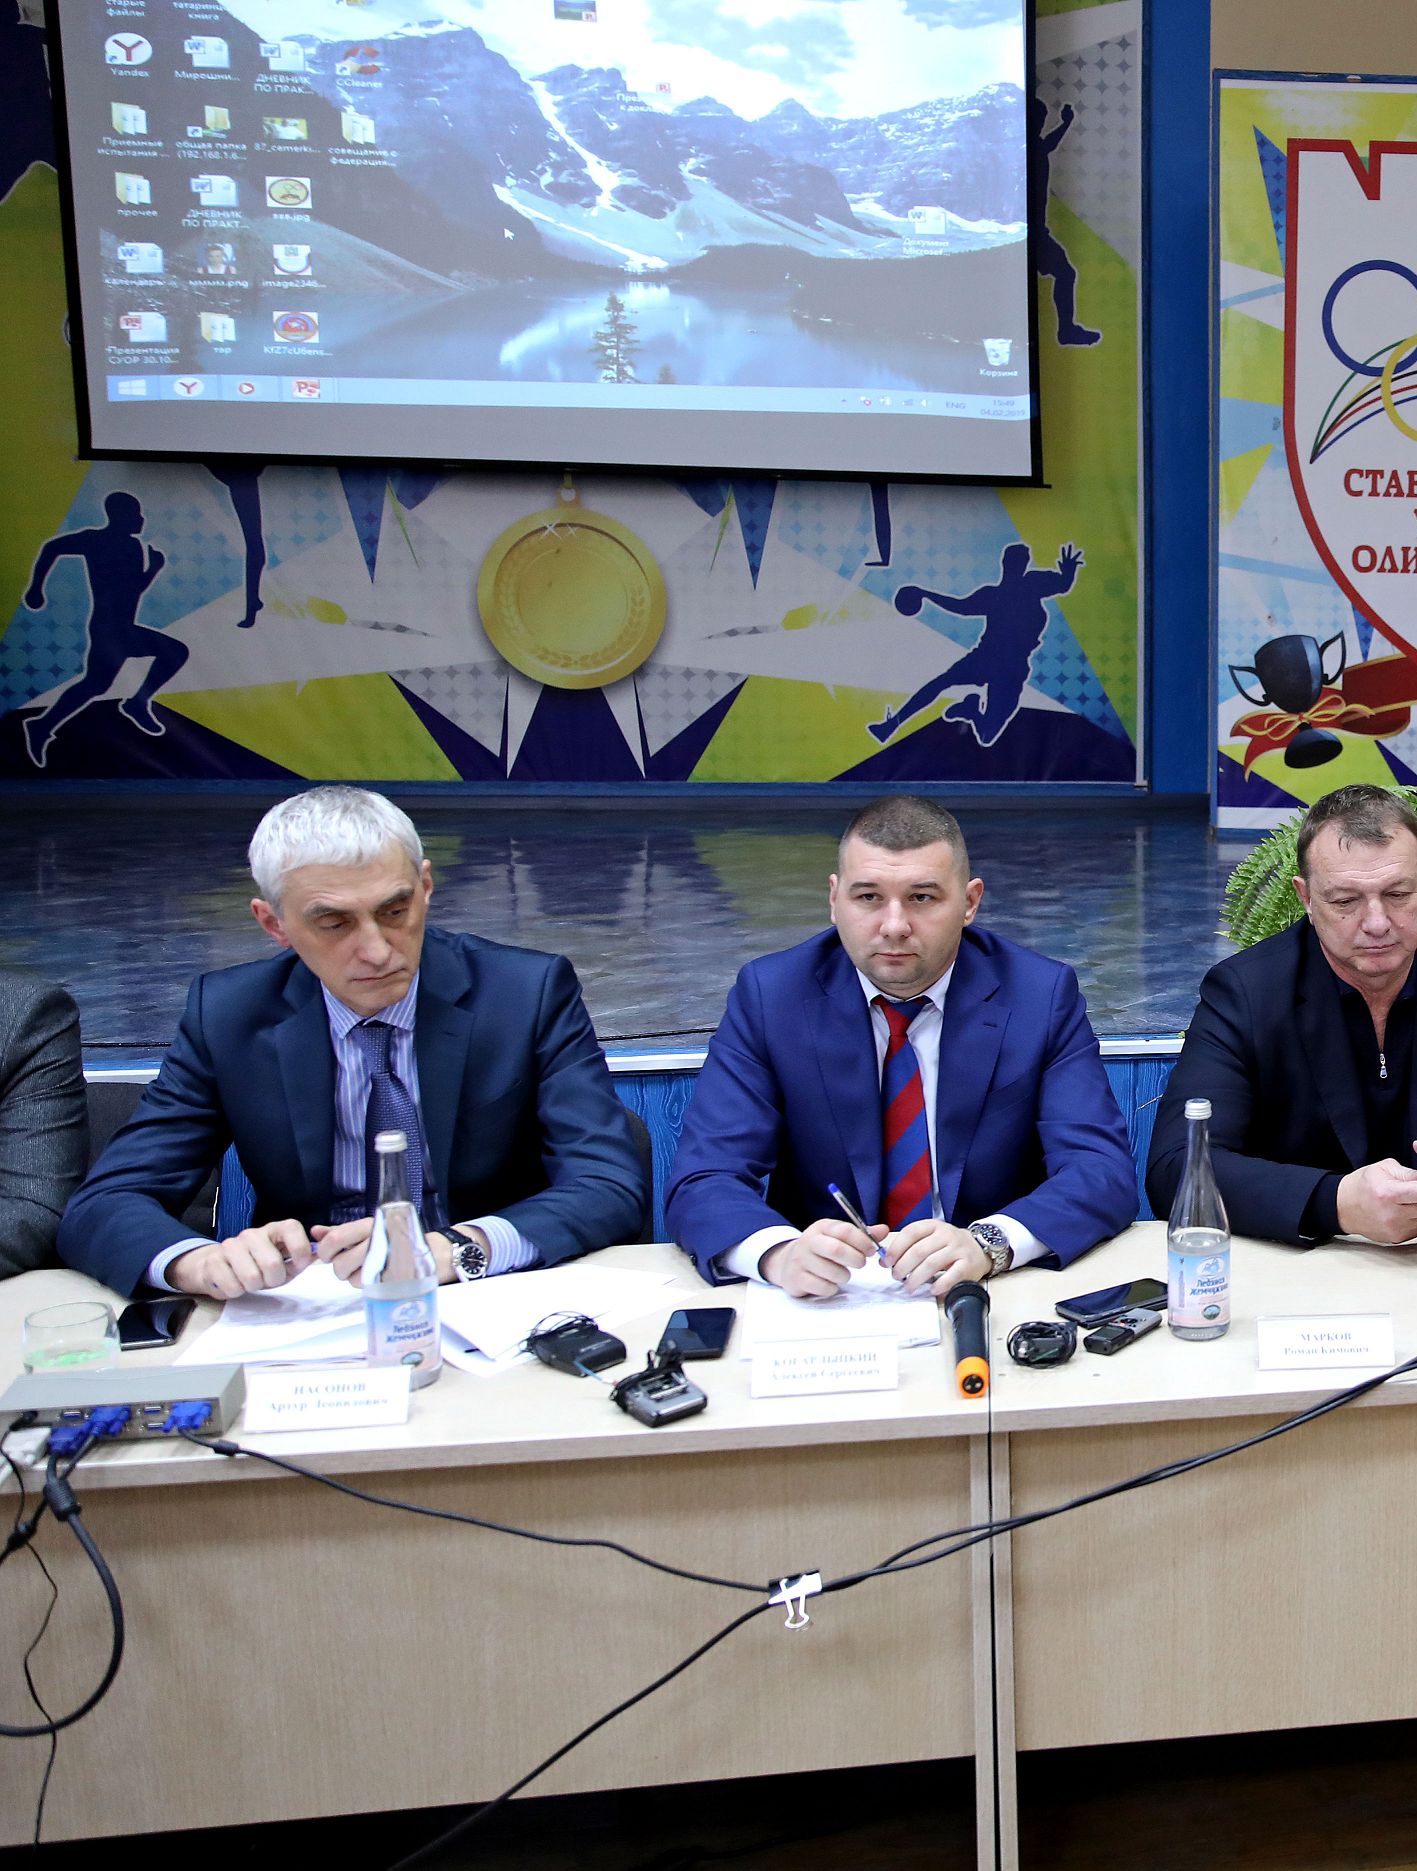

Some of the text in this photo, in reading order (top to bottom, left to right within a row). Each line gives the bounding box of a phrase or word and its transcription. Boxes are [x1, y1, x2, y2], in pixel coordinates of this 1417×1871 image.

[110, 68, 150, 78] Yandex
[181, 218, 201, 228] ПО
[979, 369, 1019, 378] Корзина
[1300, 1332, 1352, 1342] МАРКОВ
[293, 1382, 367, 1396] НАСОНОВ
